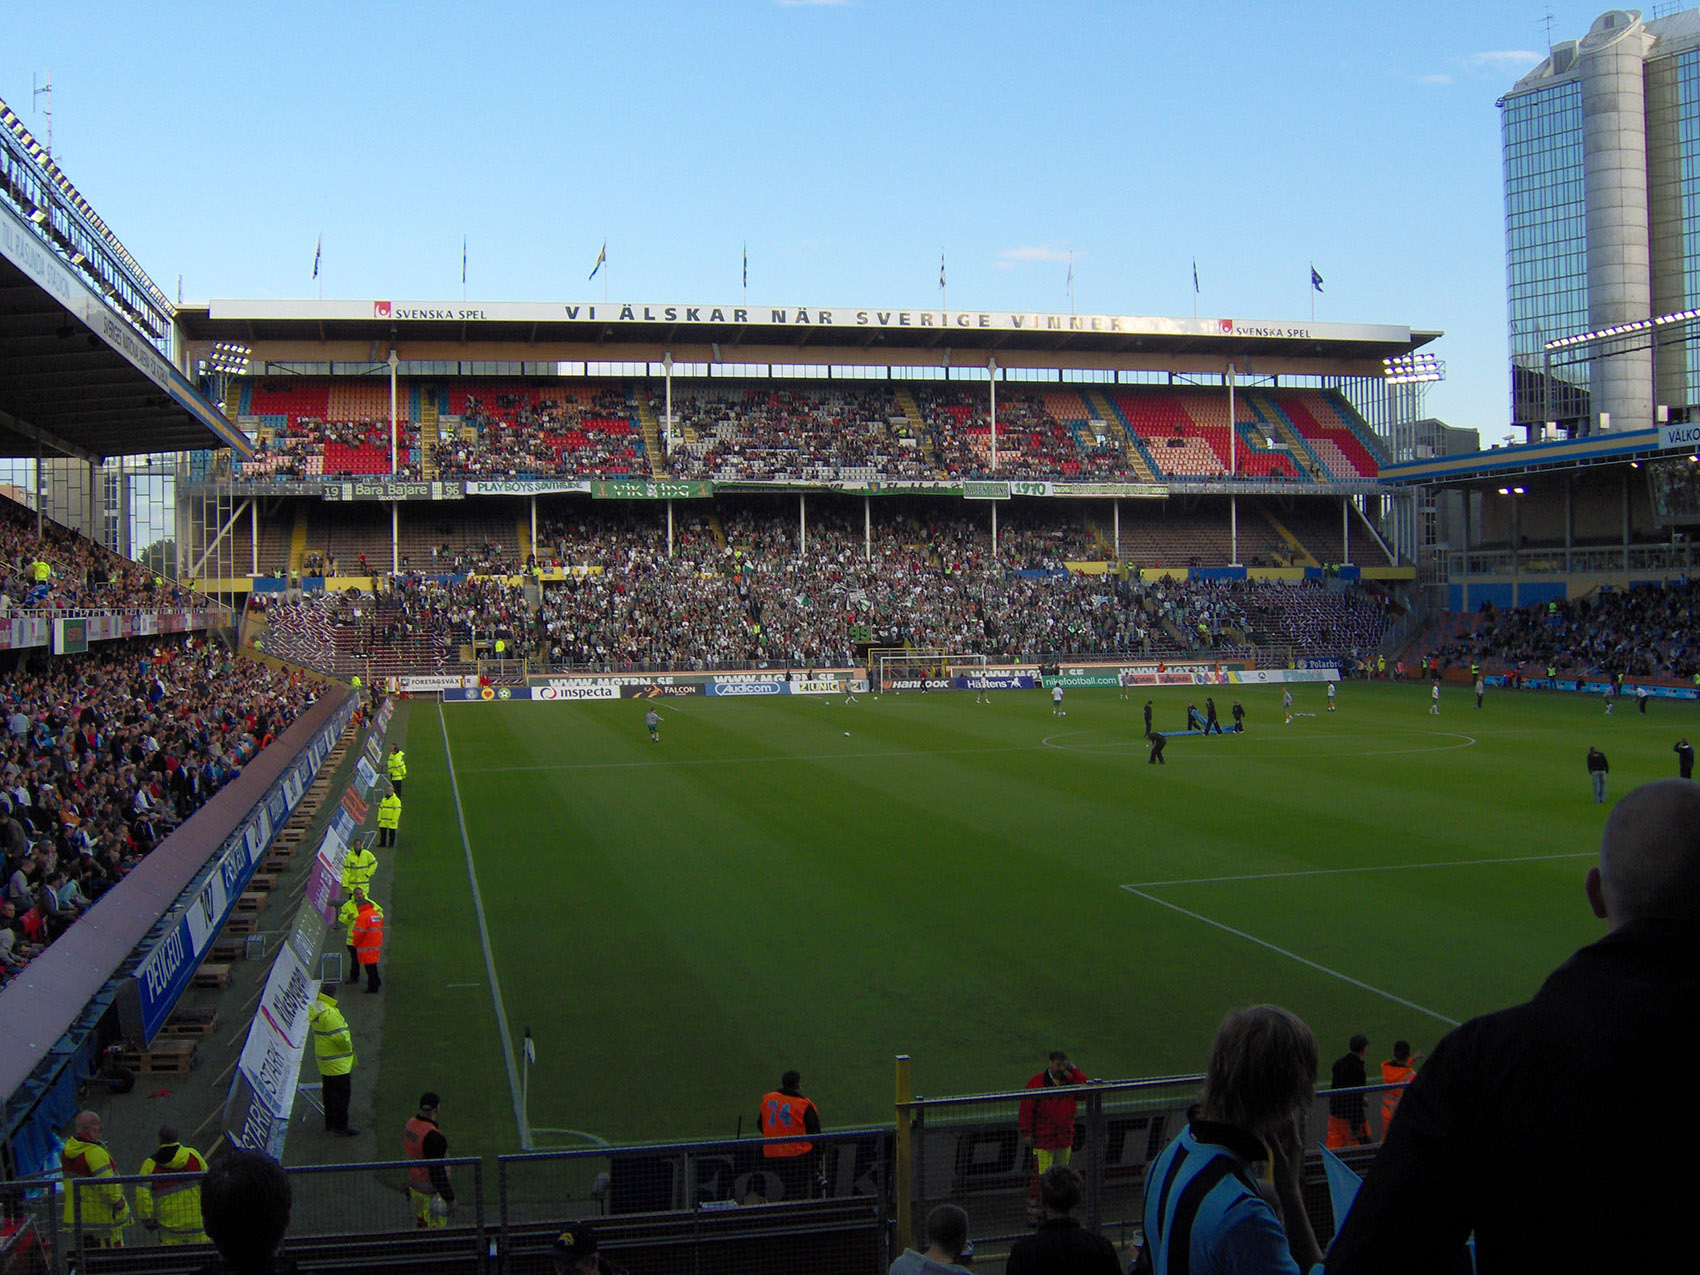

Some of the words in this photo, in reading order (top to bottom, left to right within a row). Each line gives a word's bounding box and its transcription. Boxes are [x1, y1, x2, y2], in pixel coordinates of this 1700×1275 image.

[395, 309, 454, 319] SVENSKA
[458, 310, 487, 320] SPEL
[564, 306, 596, 320] VI
[619, 304, 748, 322] ÄLSKAR
[771, 308, 833, 325] NÄR
[856, 311, 991, 328] SVERIGE
[1011, 314, 1122, 331] VINNER
[1235, 326, 1284, 337] SVENSKA
[1287, 329, 1312, 338] SPEL
[355, 484, 384, 495] Bara
[388, 484, 428, 499] Bajare
[477, 482, 533, 492] PLAYBOYS
[967, 679, 1008, 688] Hätens
[1045, 676, 1118, 686] nikefootball.com
[560, 687, 612, 699] inspecta
[664, 686, 696, 694] FALCON
[146, 927, 184, 1003] PEUGEOT
[273, 966, 310, 1031] Riksbyggen
[259, 1041, 285, 1096] STARK
[768, 1100, 792, 1126] 74
[241, 1093, 272, 1151] STARK
